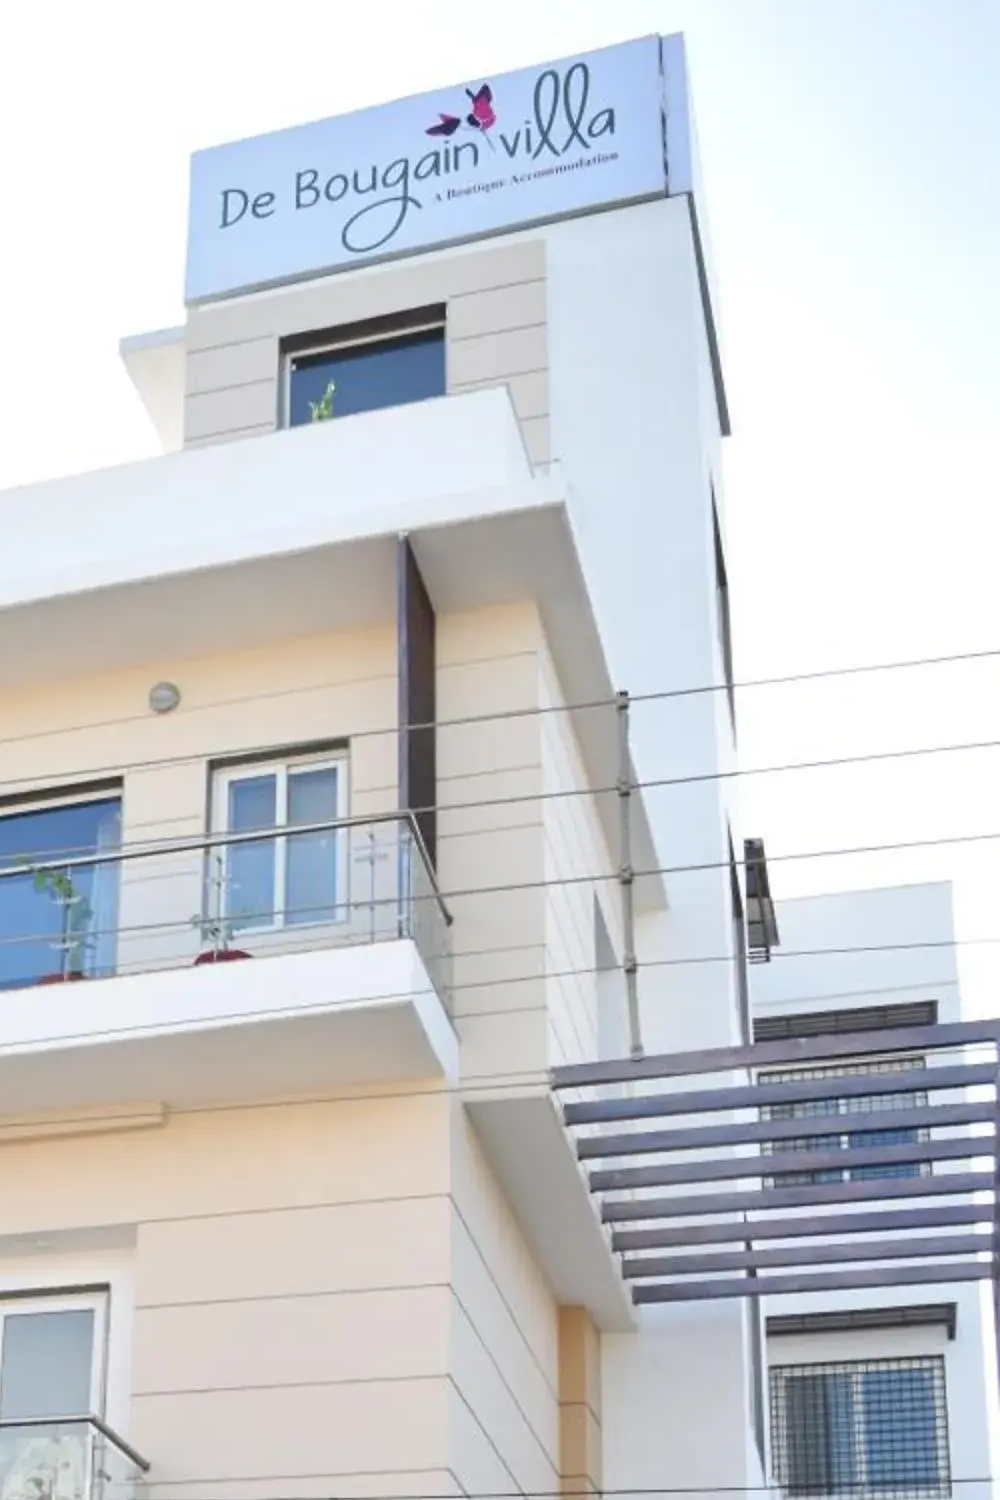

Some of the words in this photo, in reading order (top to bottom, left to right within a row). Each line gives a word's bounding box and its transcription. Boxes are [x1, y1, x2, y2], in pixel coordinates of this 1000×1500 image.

[219, 188, 276, 229] De
[294, 139, 479, 253] Bougain
[499, 62, 616, 160] villa
